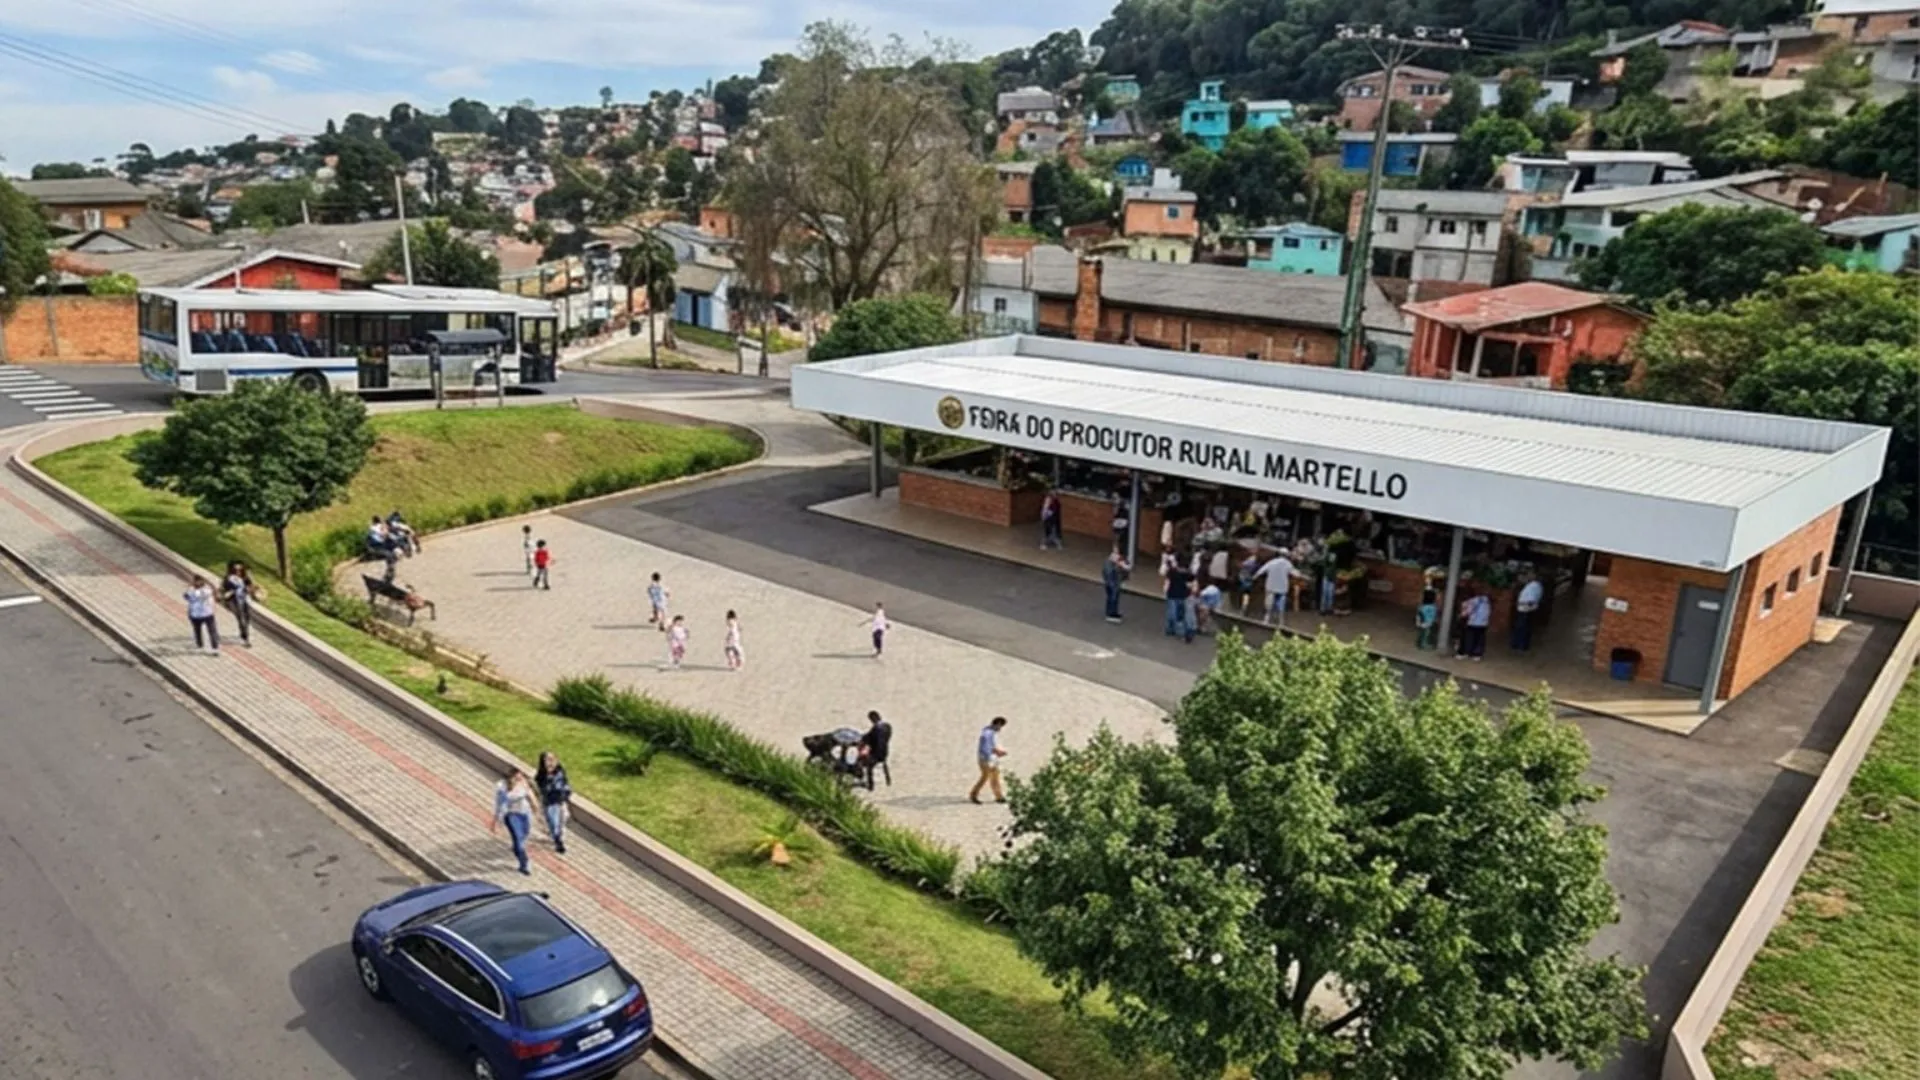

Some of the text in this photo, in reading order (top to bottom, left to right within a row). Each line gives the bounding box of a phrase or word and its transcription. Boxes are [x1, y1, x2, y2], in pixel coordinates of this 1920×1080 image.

[1027, 415, 1054, 440] DO
[1179, 440, 1256, 475] RURAL
[1264, 452, 1407, 500] MARTELLO
